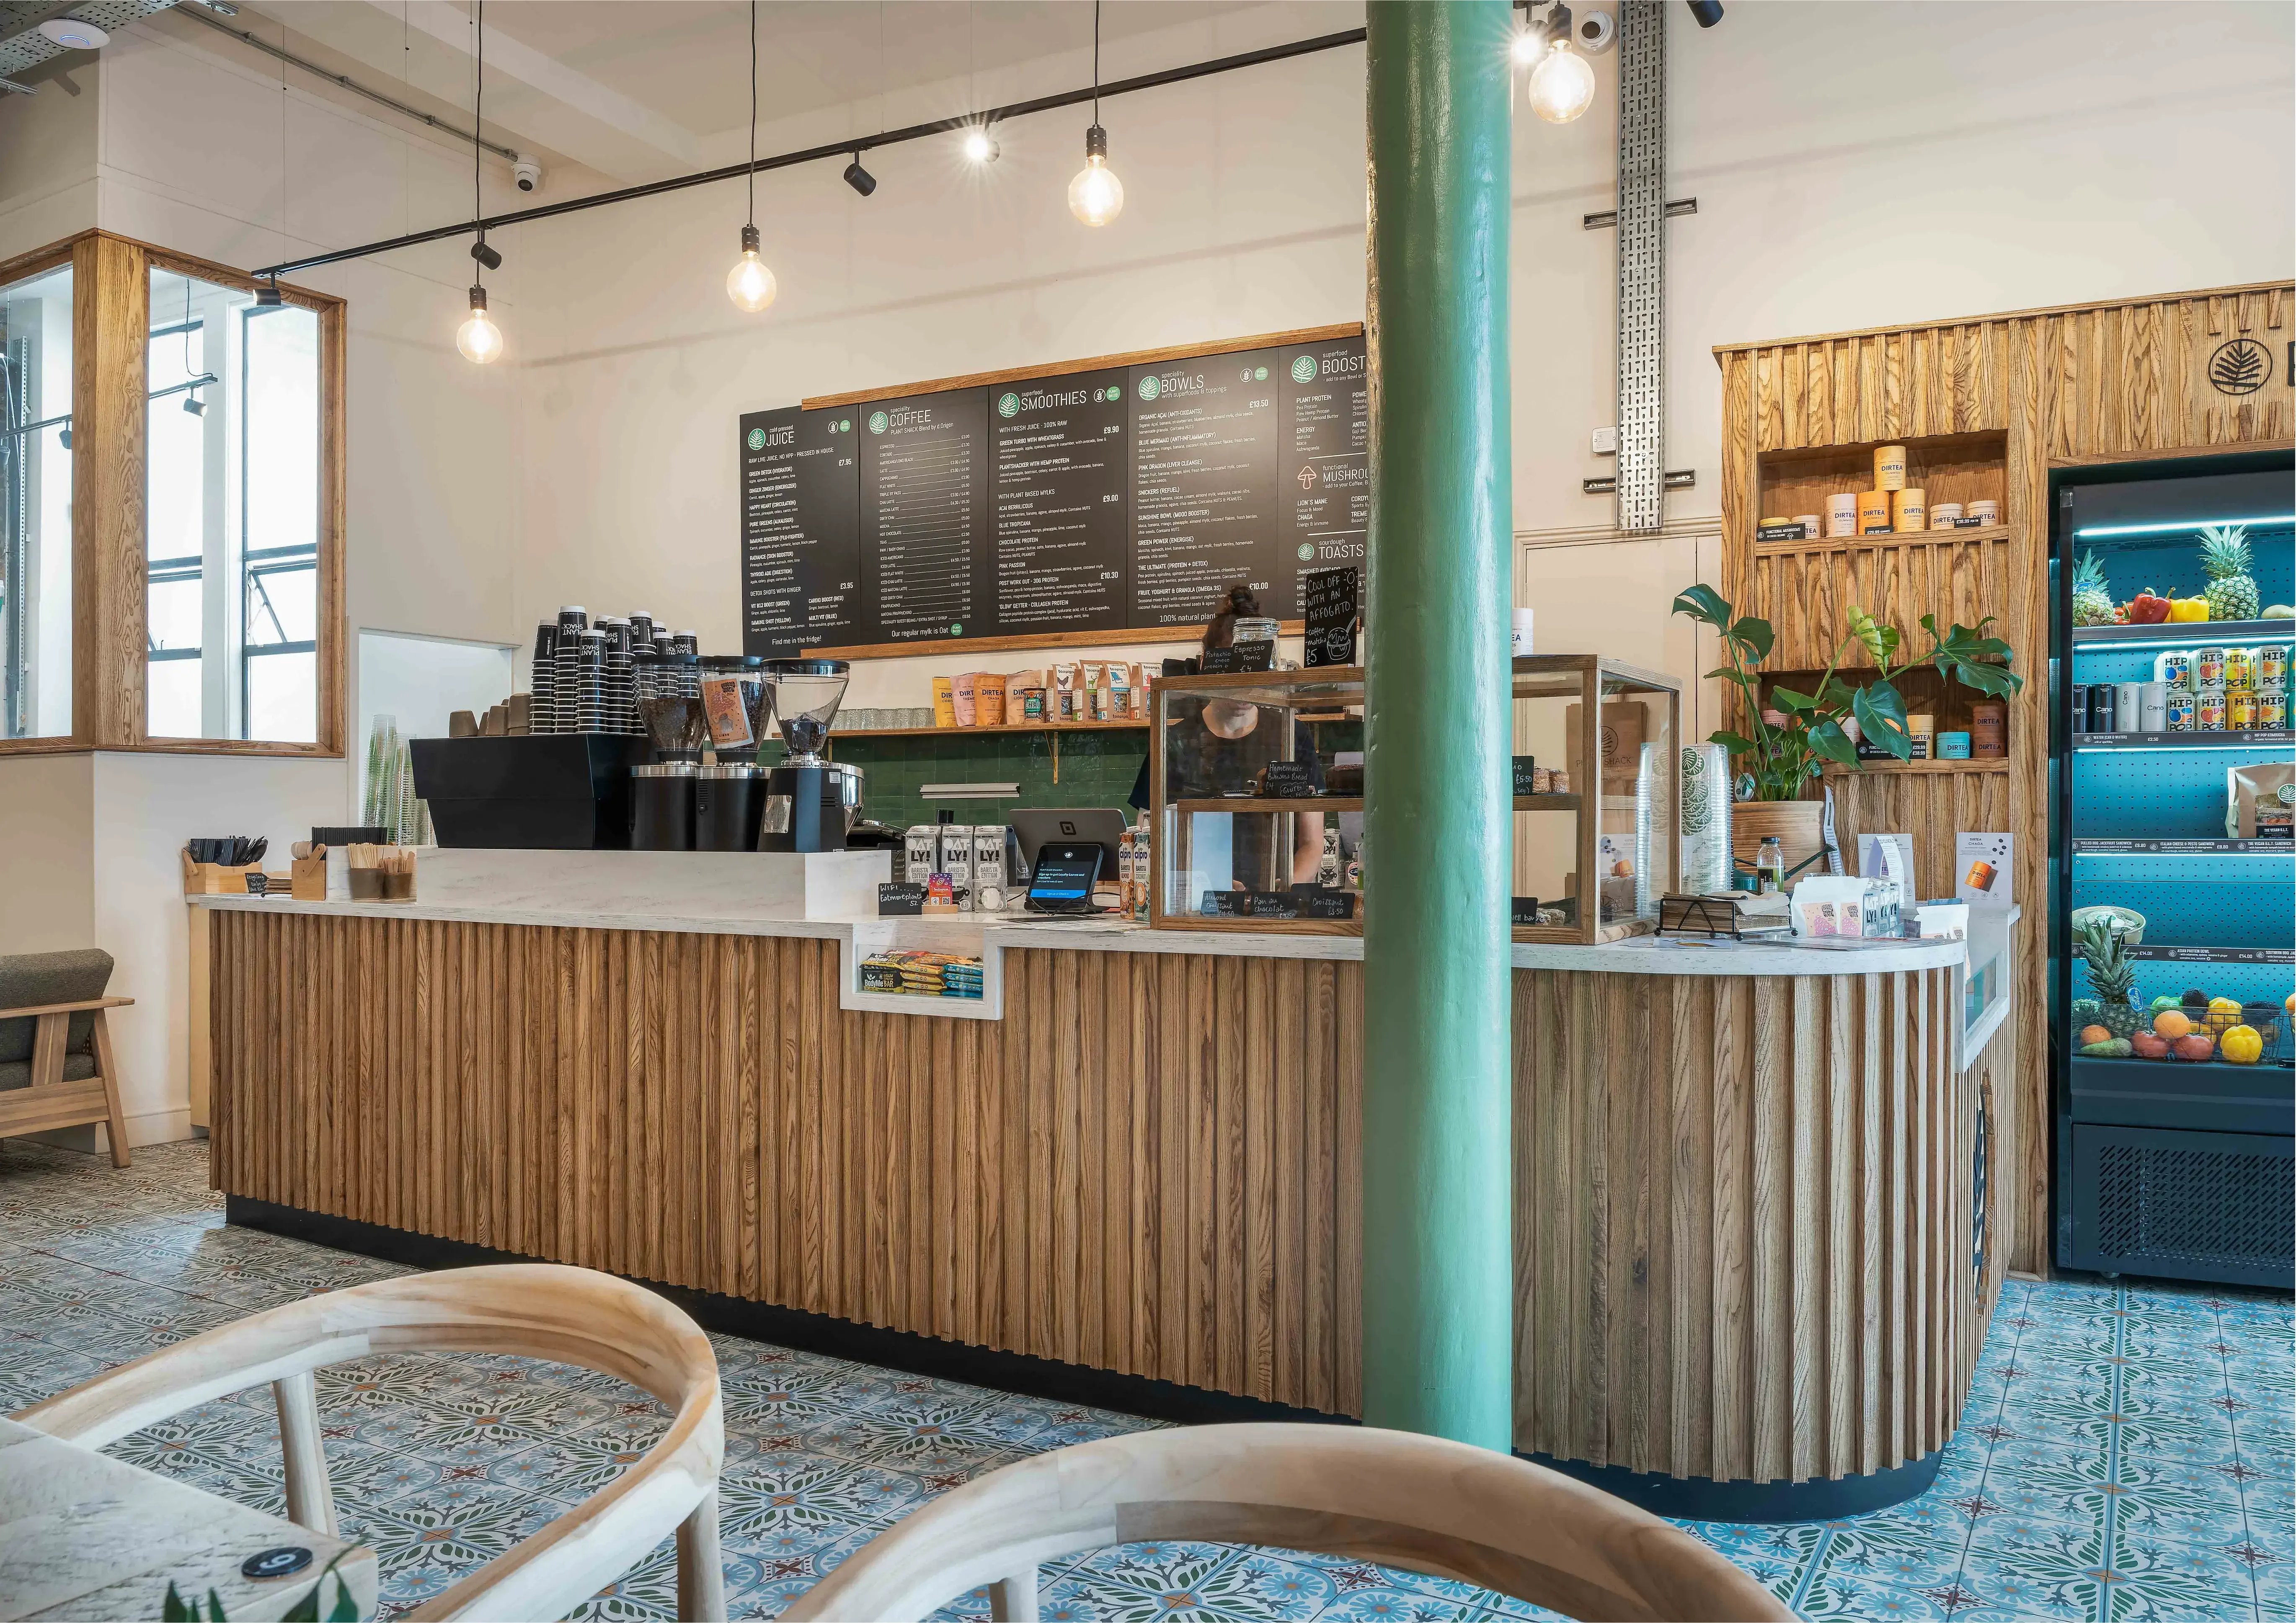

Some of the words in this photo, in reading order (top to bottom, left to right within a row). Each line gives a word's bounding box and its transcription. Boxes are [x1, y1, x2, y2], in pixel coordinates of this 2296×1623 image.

[1323, 349, 1347, 358] superfood
[1162, 371, 1184, 379] speciality
[1162, 375, 1204, 392] BOWLS
[1021, 390, 1086, 410] SMOOTHIES
[1250, 400, 1268, 408] £13.50
[891, 410, 931, 426] COFFEE
[1104, 426, 1119, 434] £9.90
[767, 431, 794, 446] JUICE
[1319, 544, 1363, 559] TOASTS
[1308, 580, 1325, 593] COOL
[1328, 575, 1340, 587] OFF
[1307, 593, 1325, 607] WITH
[1331, 588, 1340, 600] AN
[1234, 645, 1265, 654] Espresso
[1243, 652, 1261, 661] Tonic
[1306, 648, 1317, 665] £5
[2200, 654, 2223, 663] HIP
[2262, 652, 2285, 661] HIP
[2200, 678, 2223, 686] POP
[2169, 699, 2193, 707] HIP
[1604, 756, 1632, 765] SHACK
[1292, 772, 1308, 781] Bread
[911, 850, 930, 862] LY!
[948, 850, 967, 862] LY!
[980, 850, 999, 862] LY!
[1120, 848, 1131, 862] alpro
[1135, 848, 1147, 862] alpro
[881, 893, 922, 902] Eatmoreplants
[1312, 898, 1344, 906] Croissant
[1867, 910, 1877, 923] LY!
[865, 979, 883, 988] BodyMe
